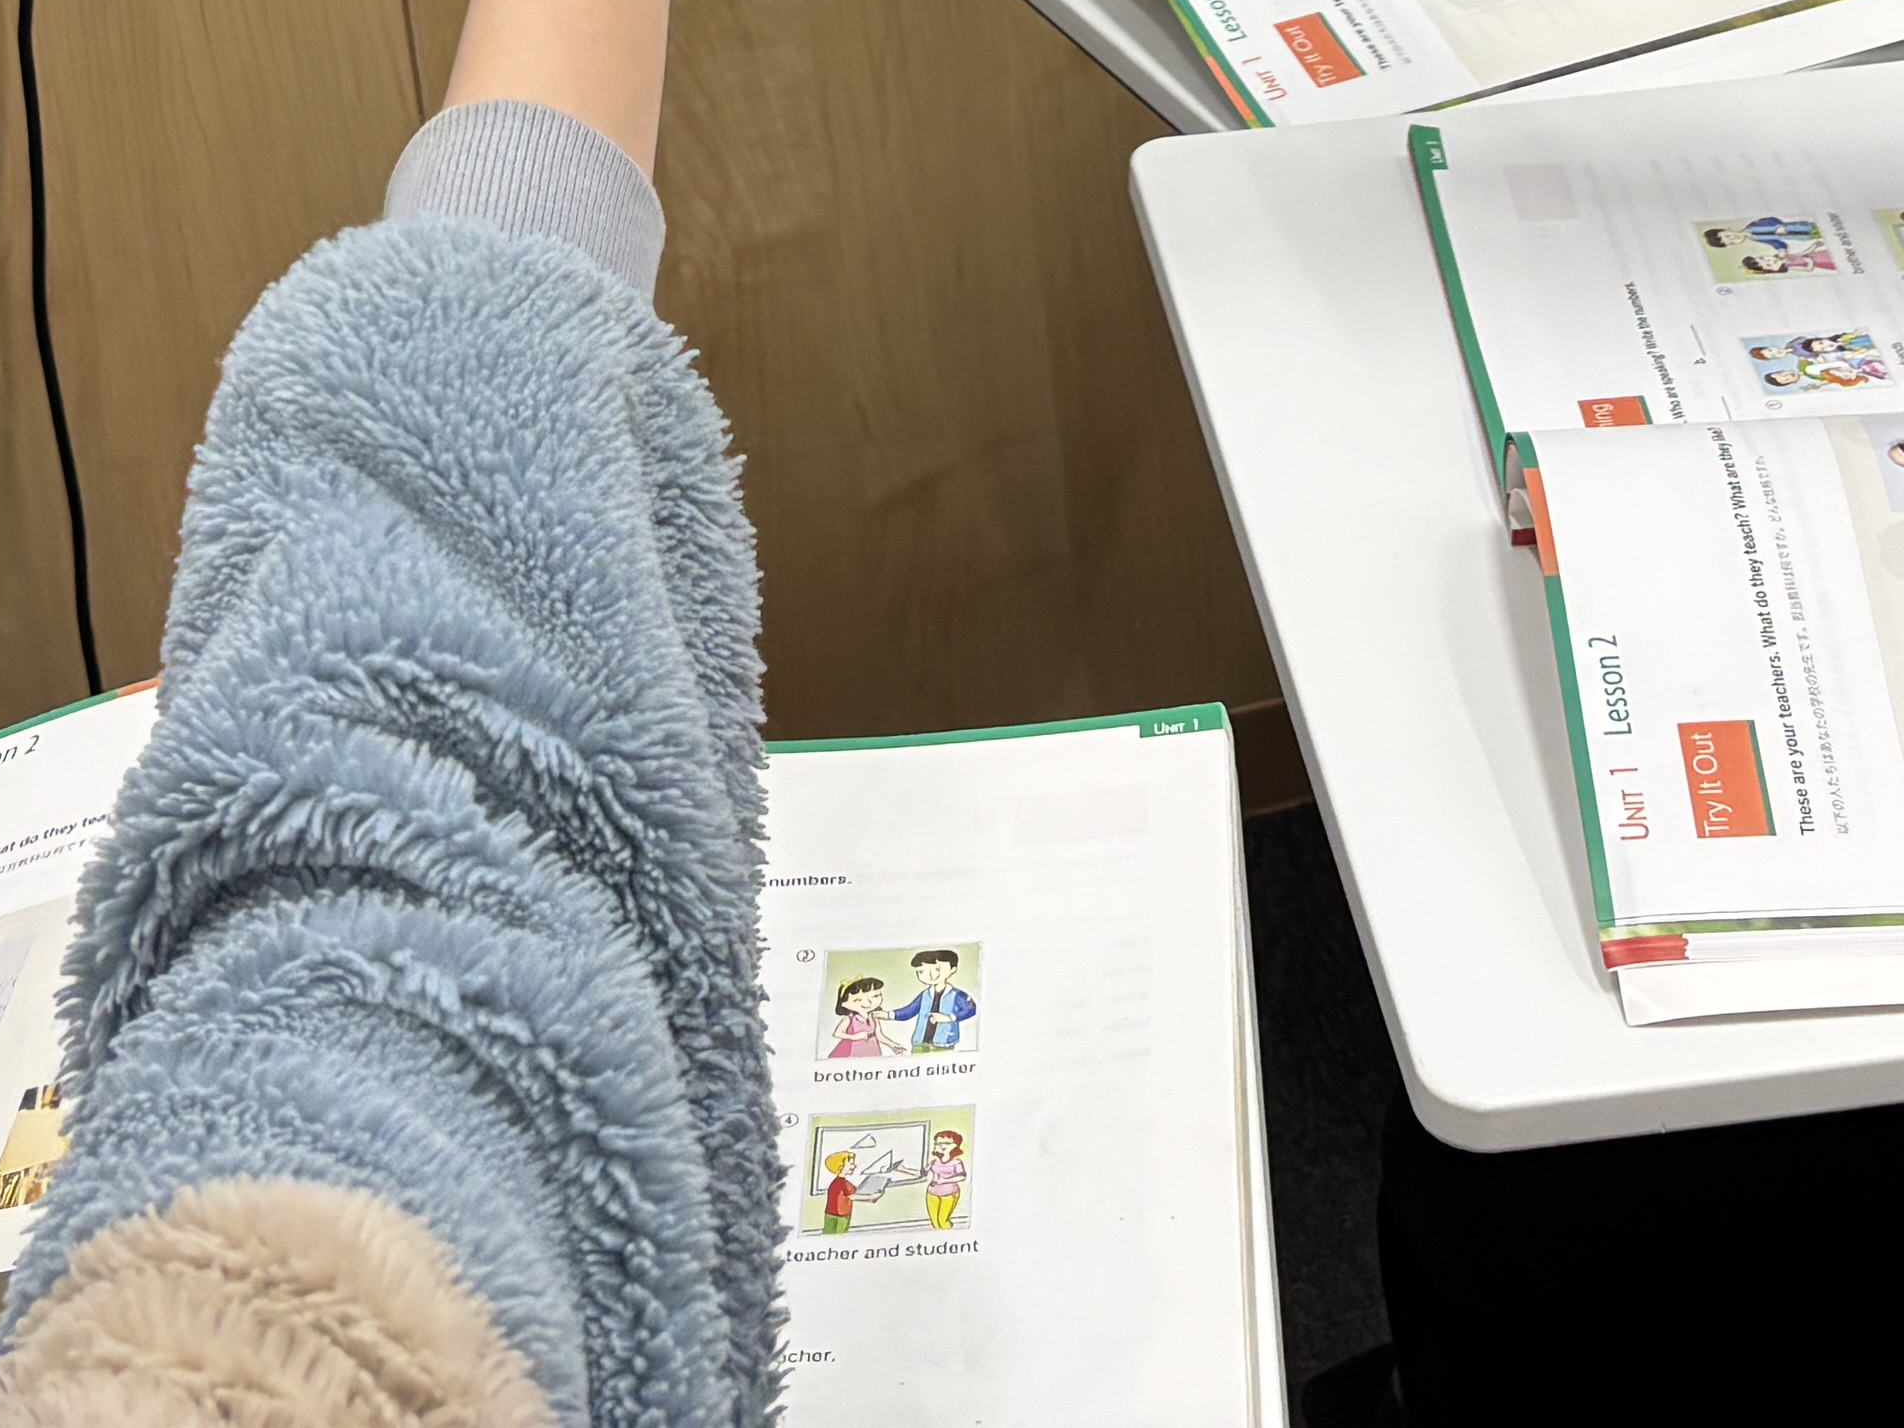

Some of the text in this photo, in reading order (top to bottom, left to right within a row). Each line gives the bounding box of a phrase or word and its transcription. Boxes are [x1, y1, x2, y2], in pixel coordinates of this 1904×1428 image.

[1285, 25, 1314, 52] Out
[1367, 42, 1391, 70] These
[1316, 63, 1337, 86] Try
[1724, 461, 1738, 479] are
[1727, 480, 1747, 510] What
[1734, 513, 1757, 555] teach?
[1749, 558, 1764, 587] they
[1753, 590, 1769, 608] do
[1588, 635, 1618, 648] 2
[1756, 611, 1777, 649] What
[1599, 655, 1632, 735] Lesson
[1769, 651, 1792, 719] teachers.
[1192, 718, 1200, 730] 1
[23, 734, 40, 755] 2
[1783, 722, 1804, 757] your
[1609, 767, 1638, 776] 1
[1691, 732, 1734, 837] Try It Out
[1790, 759, 1806, 784] are
[1796, 788, 1815, 836] These
[18, 832, 40, 850] do
[43, 822, 79, 841] they
[82, 812, 109, 829] tea
[769, 875, 852, 888] numbers.
[814, 1062, 977, 1083] brother and sister
[786, 1240, 980, 1263] teacher and student
